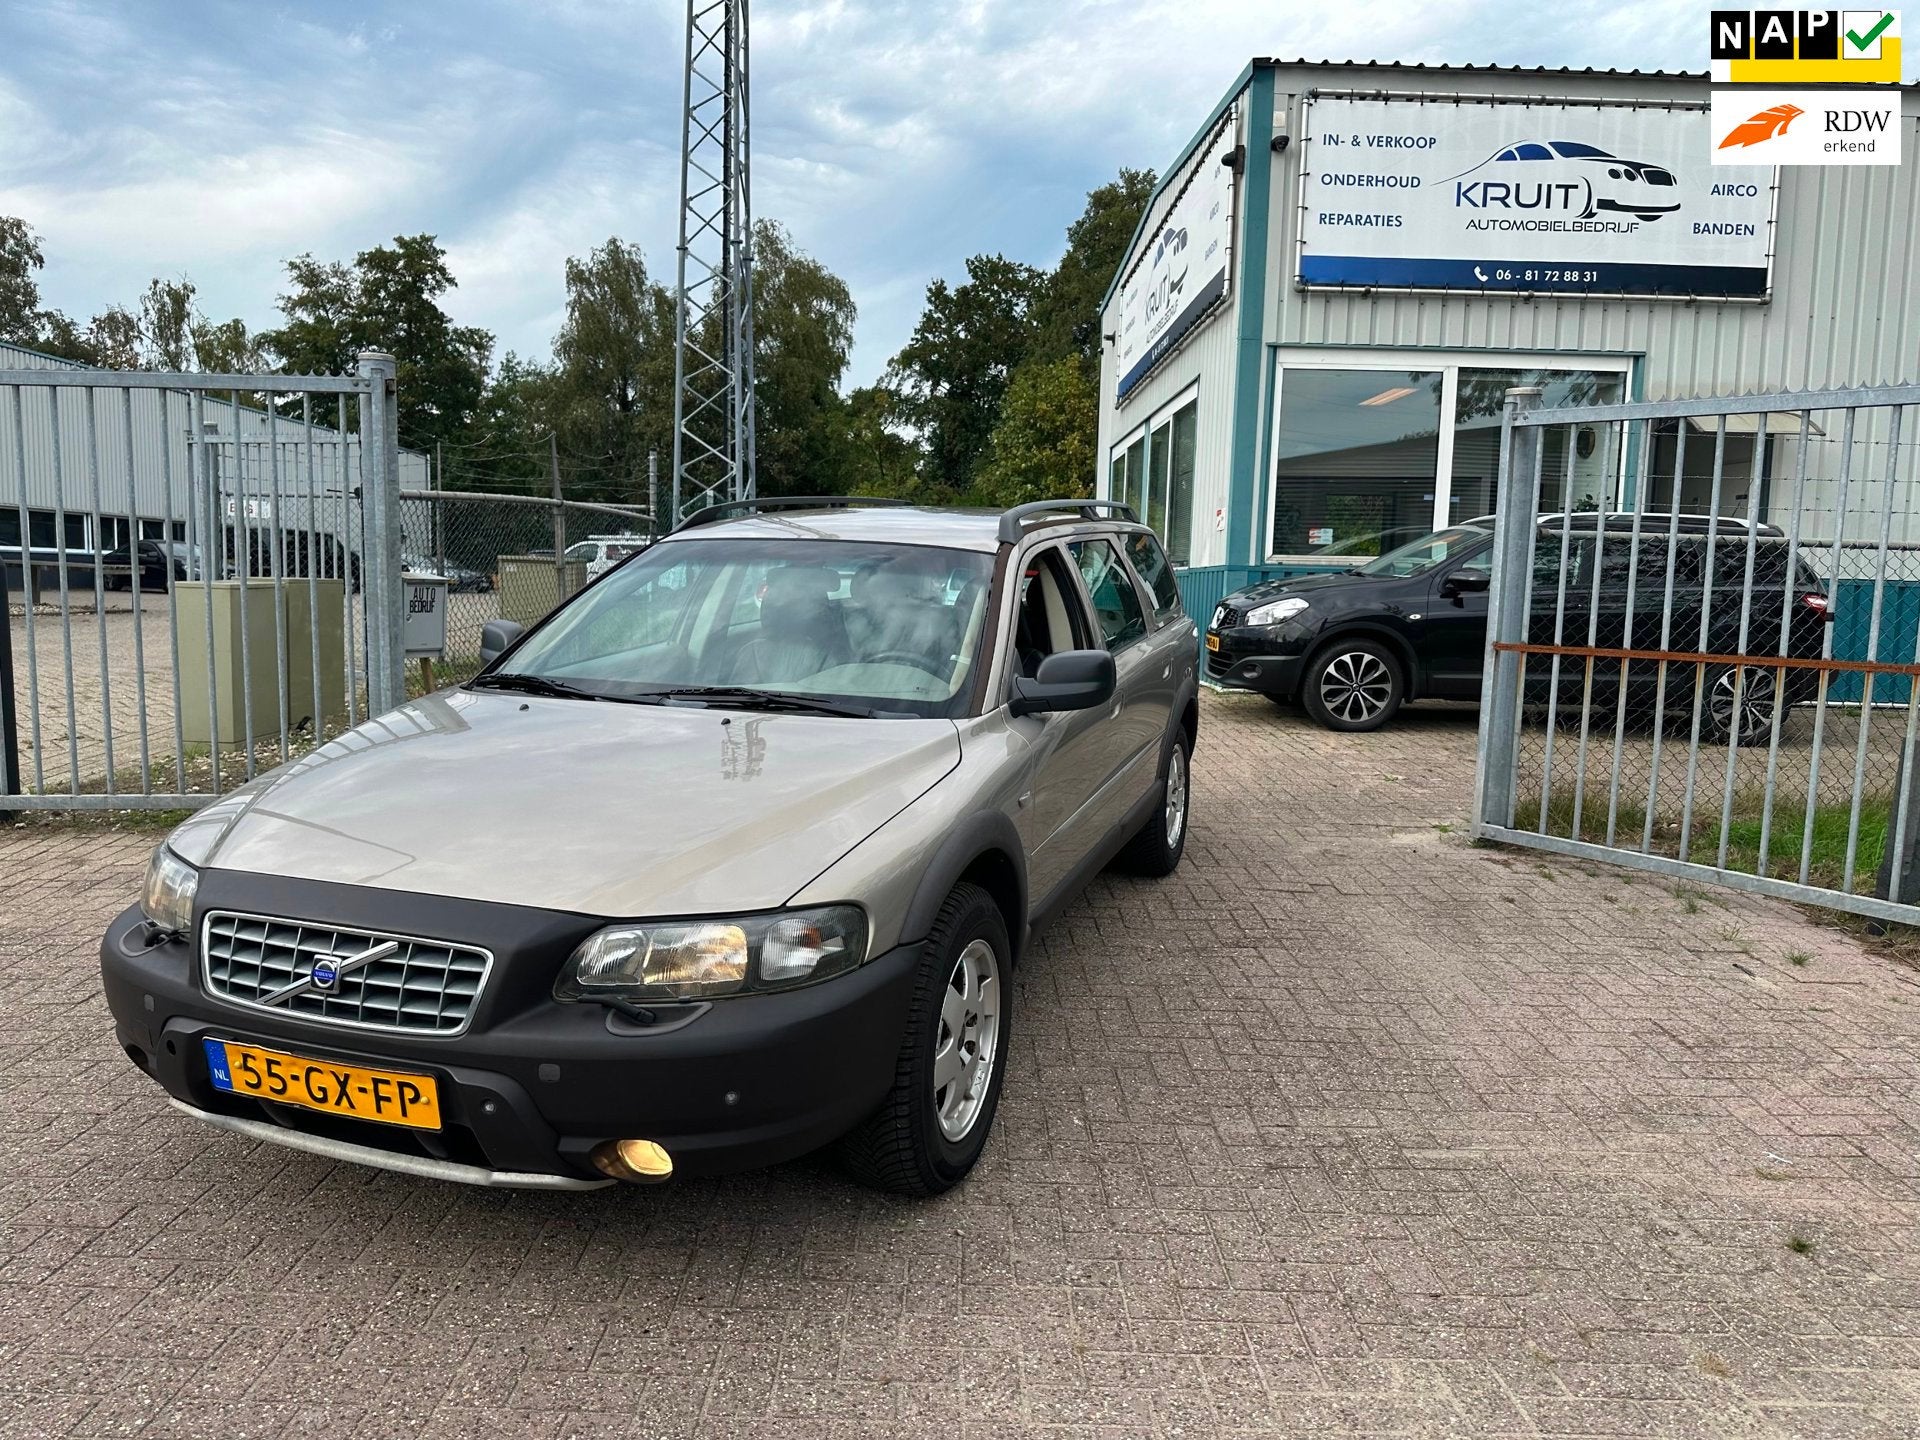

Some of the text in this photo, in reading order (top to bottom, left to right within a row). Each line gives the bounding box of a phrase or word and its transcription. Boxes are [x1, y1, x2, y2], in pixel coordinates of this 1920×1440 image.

[1322, 133, 1437, 149] IN- & VERKOOP
[1320, 173, 1421, 188] ONDERHOUD
[1455, 181, 1579, 210] KRUIT
[1710, 183, 1758, 197] AIRCO
[1318, 212, 1403, 228] REPARATIES
[1465, 218, 1640, 234] AUTOMOBIELBEDRIJF
[1692, 222, 1755, 236] BANDEN
[1495, 269, 1512, 281] 06
[1524, 270, 1539, 281] 81
[1544, 270, 1560, 282] 72
[1563, 271, 1580, 282] 88
[1583, 271, 1598, 282] 31
[413, 587, 436, 601] AUTO
[213, 1068, 230, 1082] NL
[240, 1051, 421, 1118] 55-GX-FP
